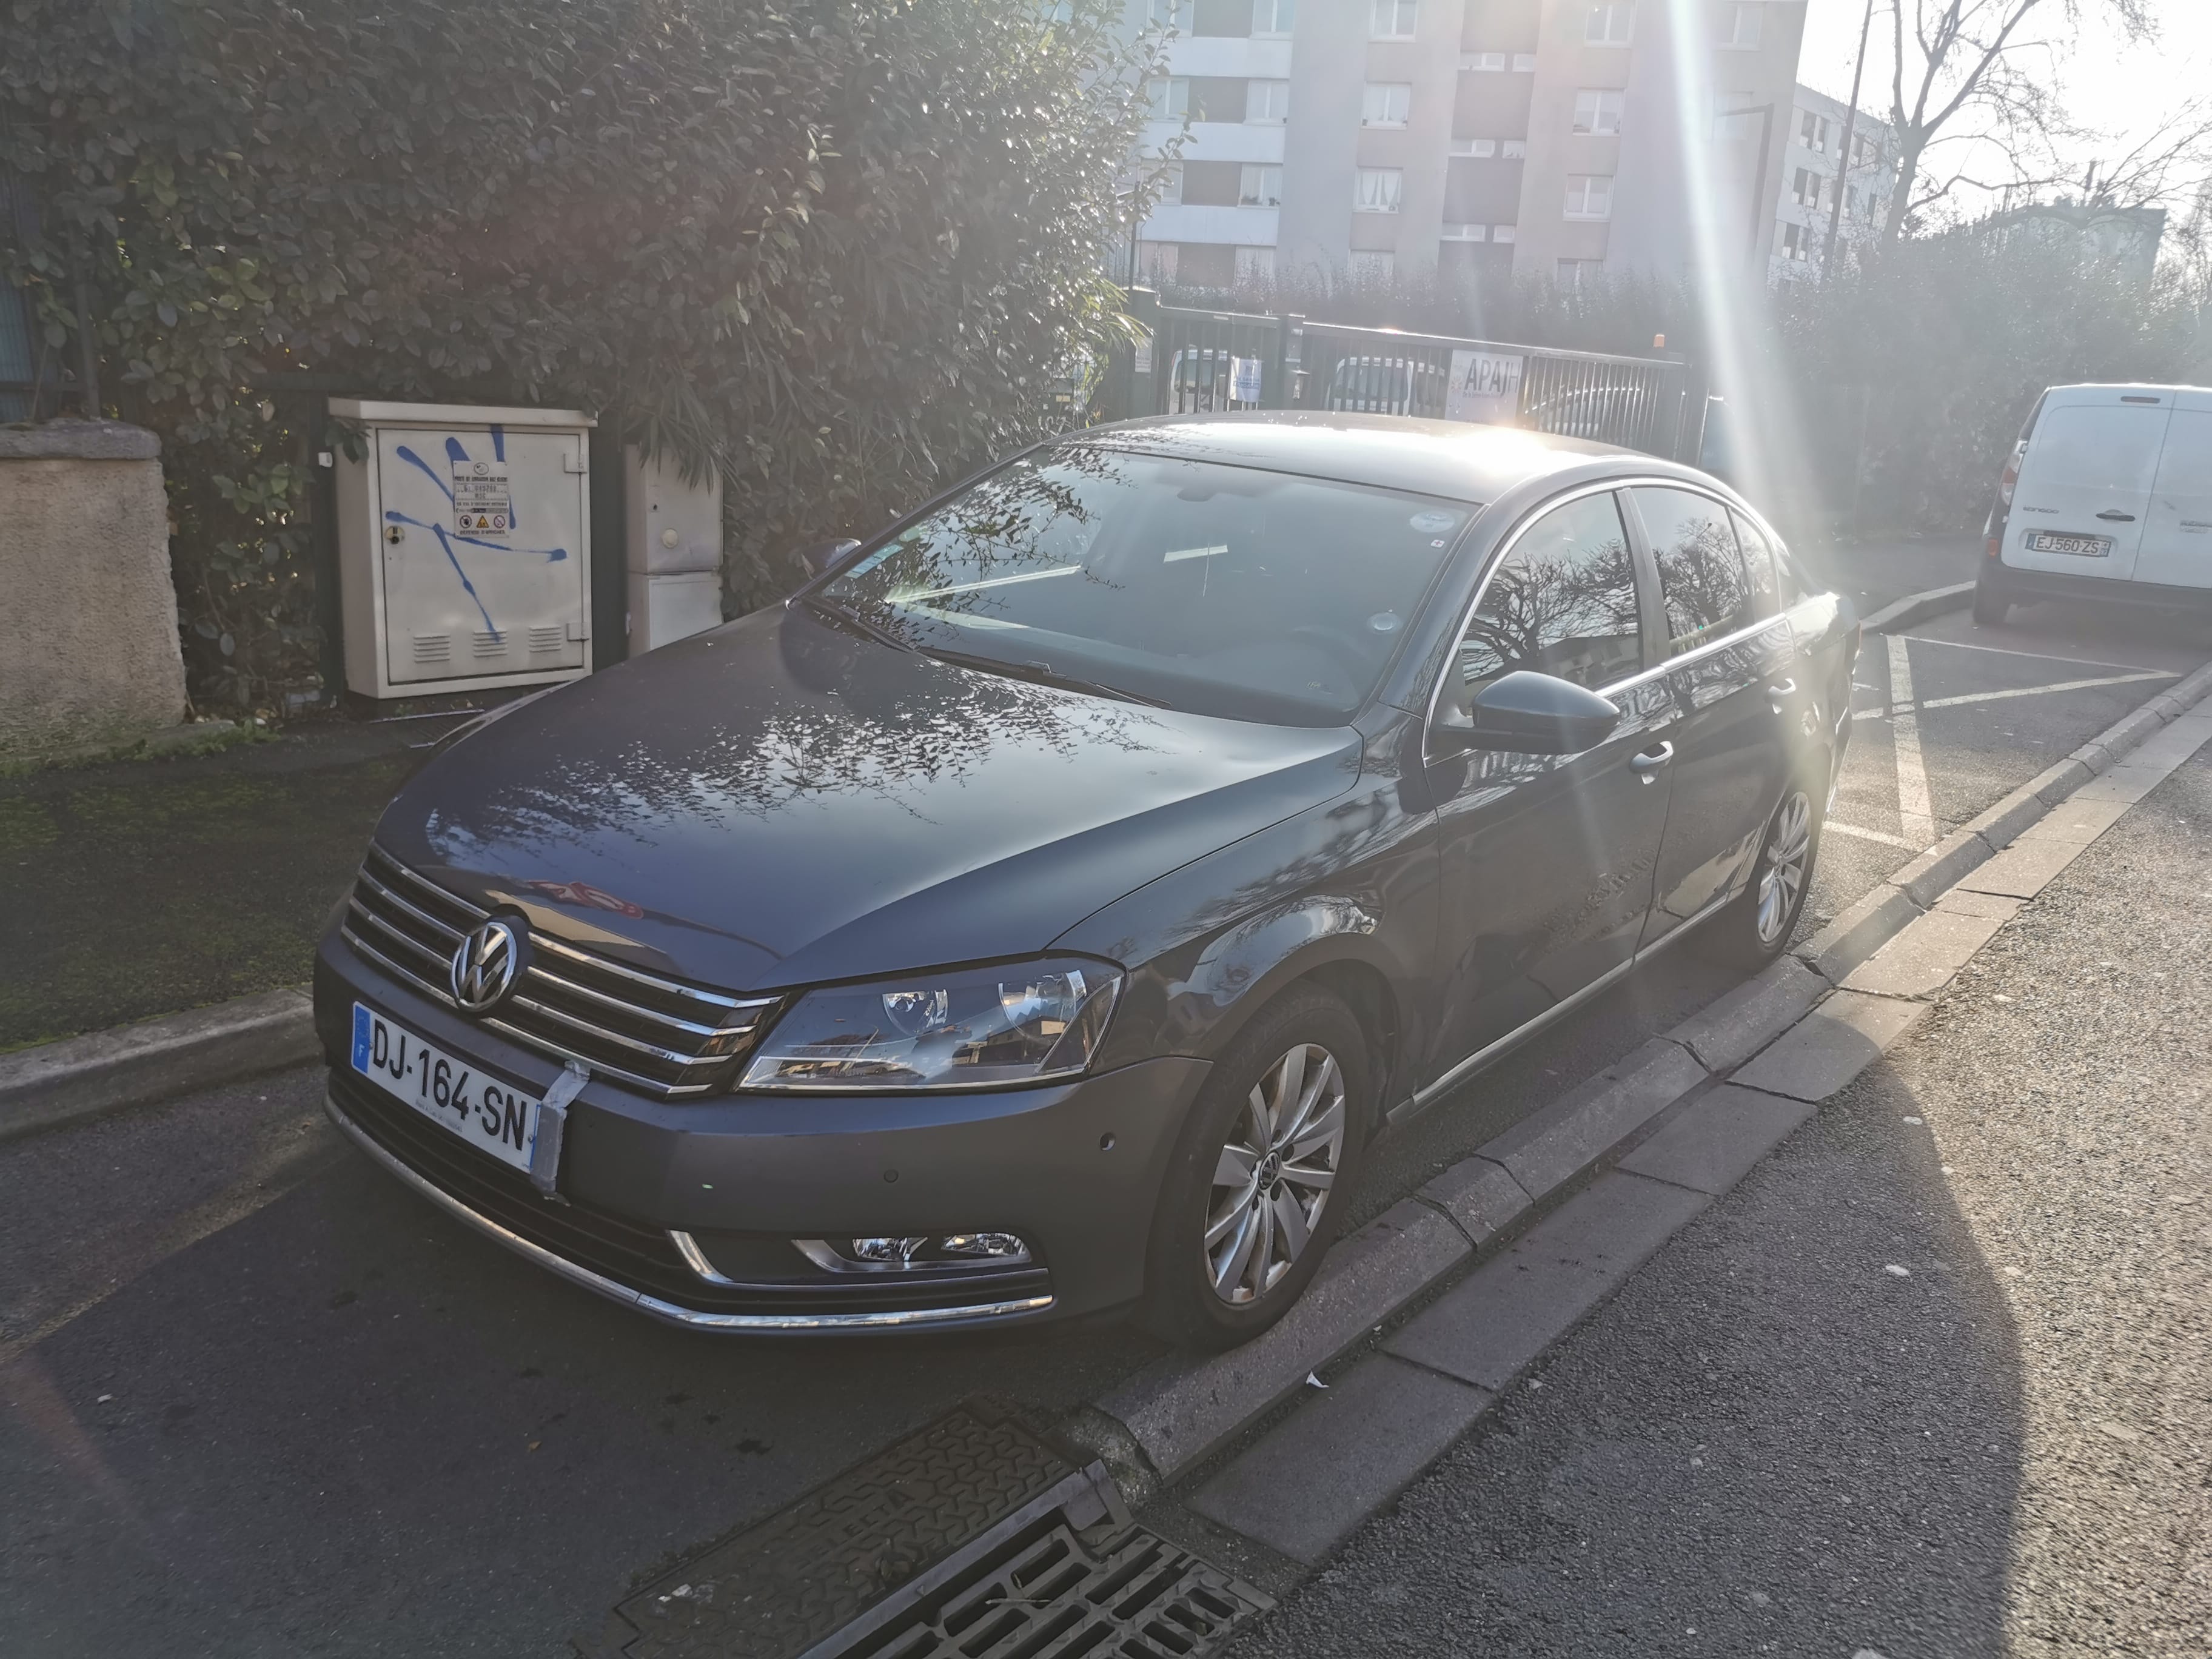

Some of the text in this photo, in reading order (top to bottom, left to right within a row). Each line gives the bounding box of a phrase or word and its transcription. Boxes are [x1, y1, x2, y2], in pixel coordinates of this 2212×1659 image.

[1464, 358, 1521, 398] APAJH
[2036, 537, 2099, 554] EJ-560-ZS
[358, 1043, 365, 1057] F
[373, 1019, 528, 1151] DJ-164-SN
